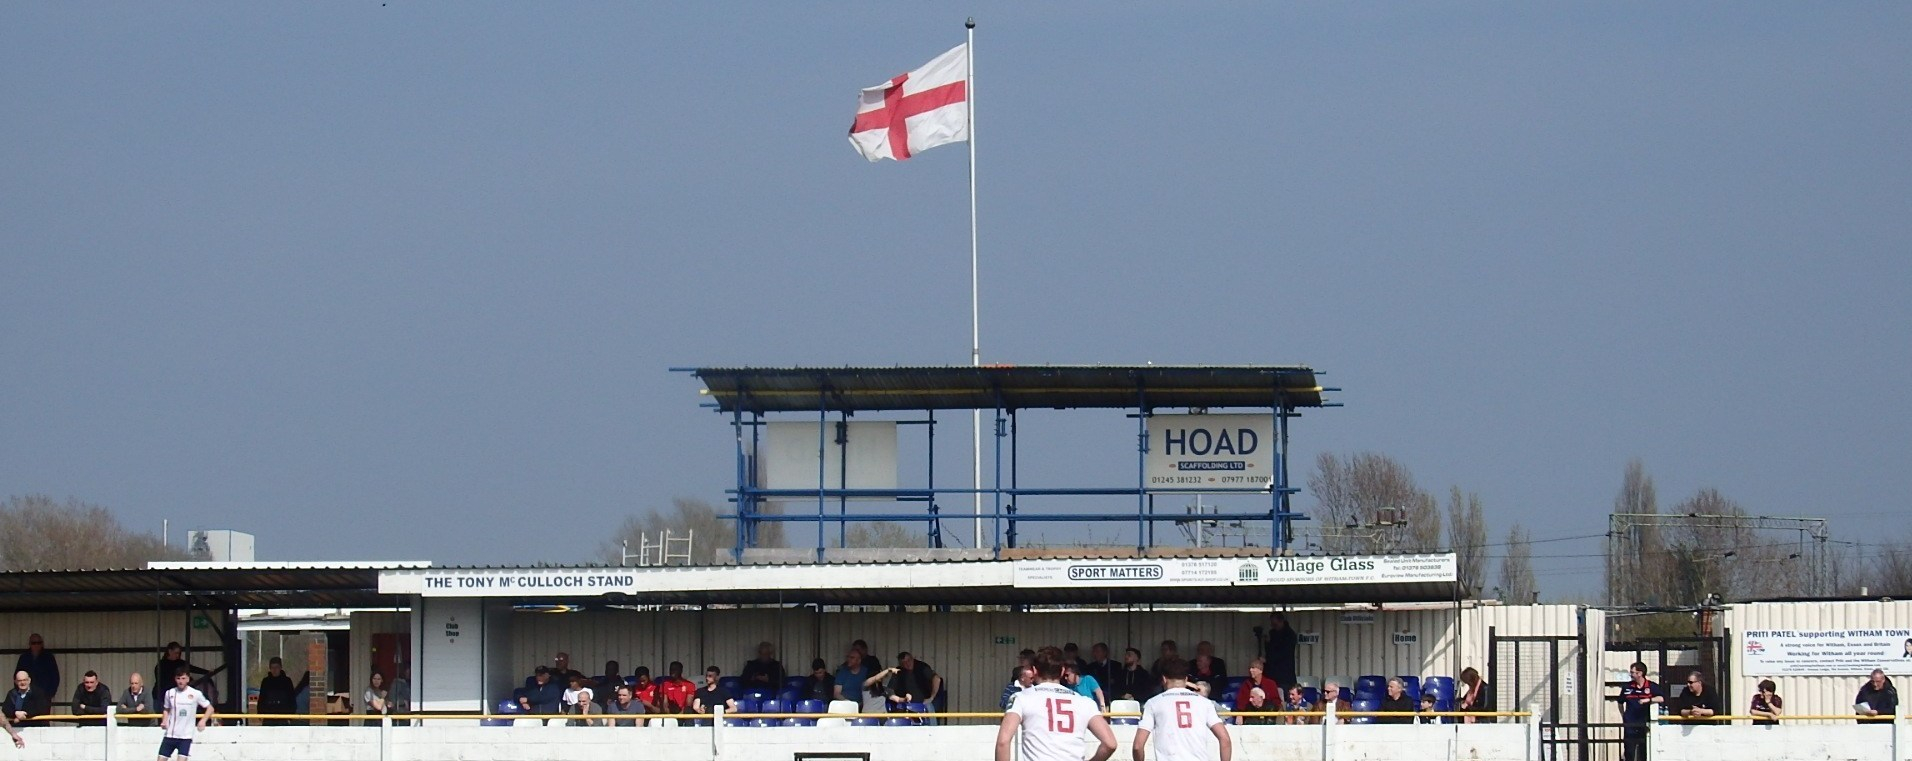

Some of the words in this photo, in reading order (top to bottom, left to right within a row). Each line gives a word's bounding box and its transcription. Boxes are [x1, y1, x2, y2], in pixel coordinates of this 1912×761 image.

[1166, 428, 1258, 455] HOAD
[1072, 568, 1106, 578] SPORT
[1110, 568, 1159, 577] MATTERS
[1266, 559, 1324, 574] Village
[1331, 558, 1374, 570] Glass
[425, 577, 452, 588] THE
[457, 577, 494, 587] TONY
[588, 576, 633, 586] STAND
[1298, 634, 1319, 643] Away
[1046, 698, 1074, 733] 15
[1176, 701, 1192, 728] 6
